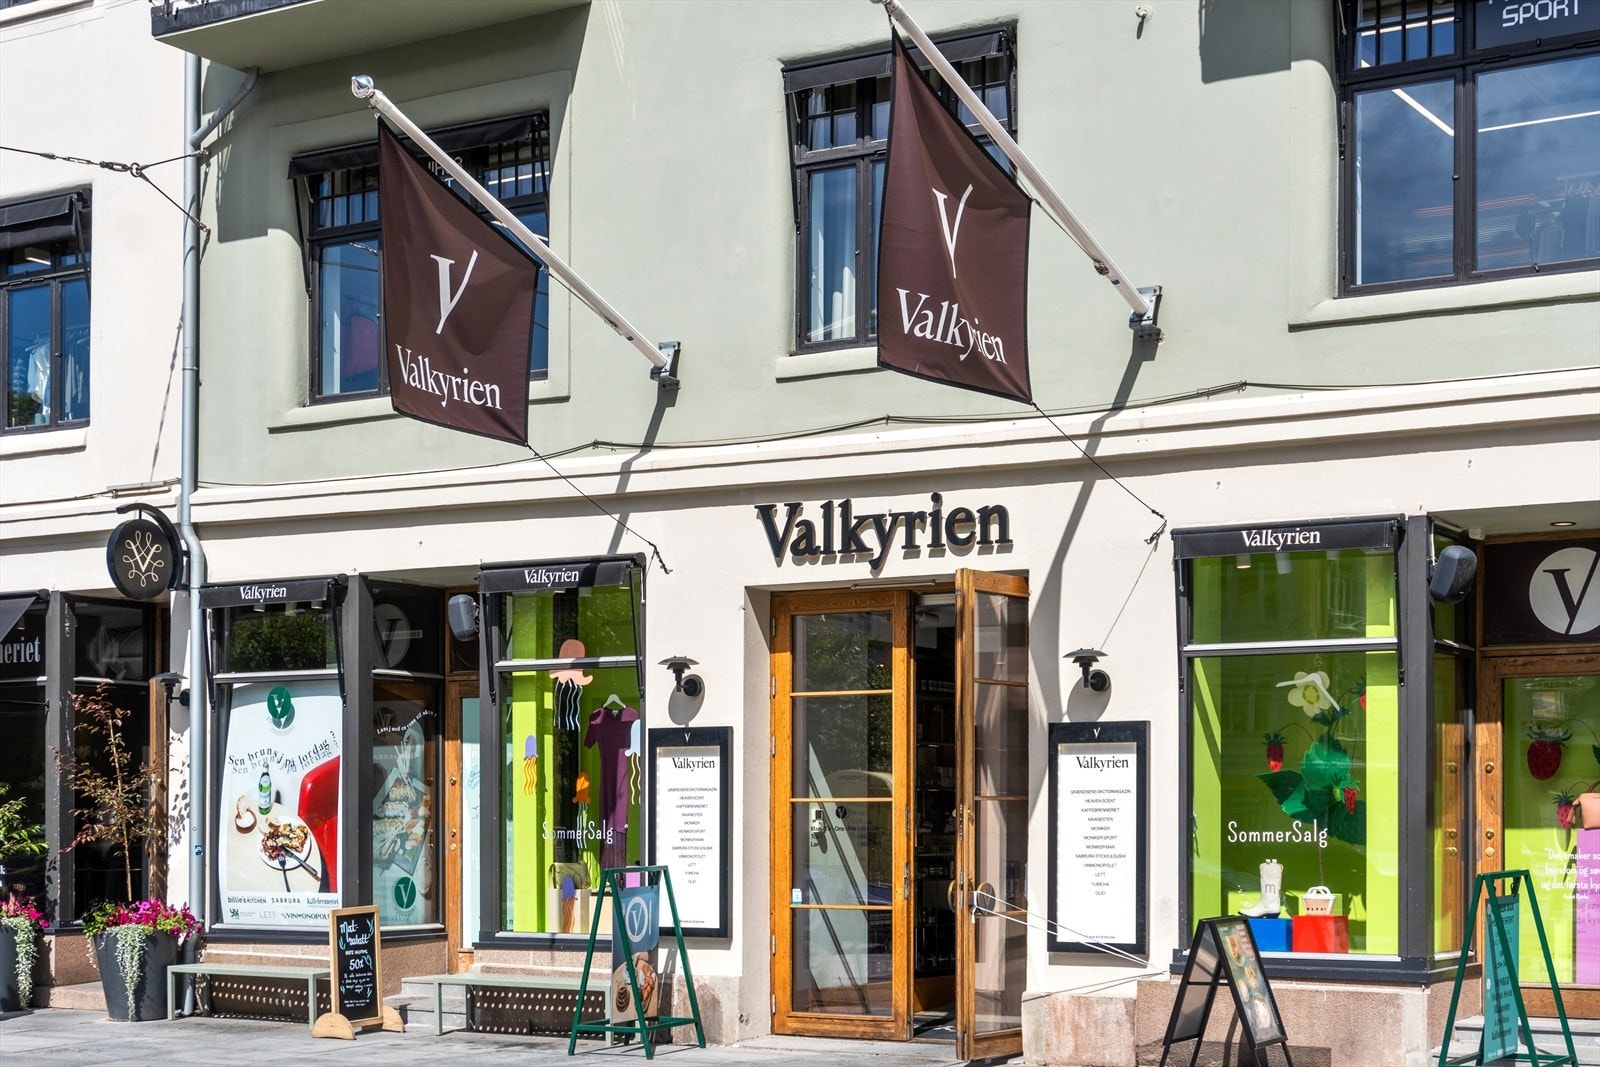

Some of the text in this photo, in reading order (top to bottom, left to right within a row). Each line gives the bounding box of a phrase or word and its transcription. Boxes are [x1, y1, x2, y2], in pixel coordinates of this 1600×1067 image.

[932, 184, 974, 279] V
[430, 250, 478, 334] V
[896, 288, 1007, 365] Valkyrien
[395, 344, 502, 409] Valkyrien
[754, 492, 1014, 571] Valkyrien
[1241, 527, 1321, 552] Valkyrien
[524, 567, 579, 587] Valkyrien
[240, 584, 287, 603] Valkyrien
[672, 757, 715, 772] Valkyrien
[1076, 756, 1129, 772] Valkyrien
[542, 819, 614, 845] SommerSalg
[1227, 819, 1328, 848] SommerSalg
